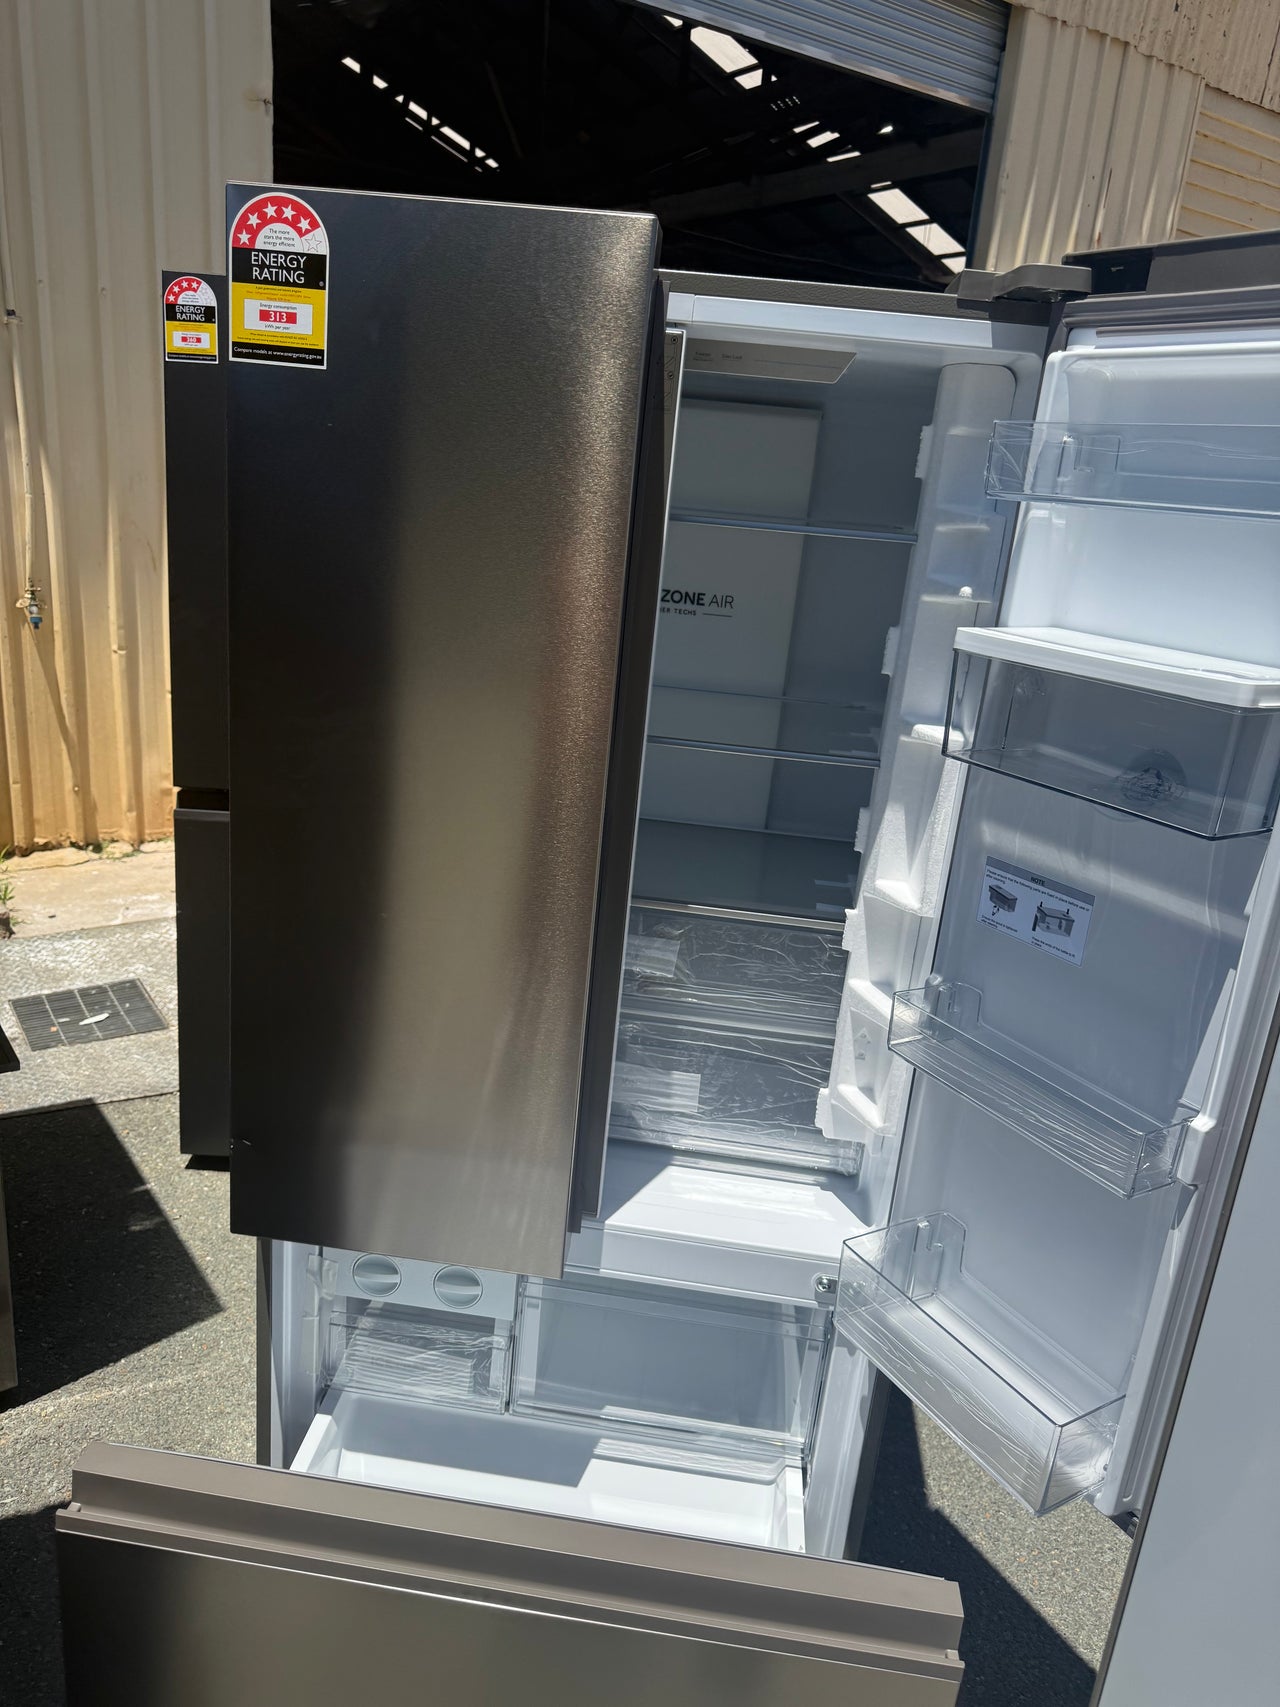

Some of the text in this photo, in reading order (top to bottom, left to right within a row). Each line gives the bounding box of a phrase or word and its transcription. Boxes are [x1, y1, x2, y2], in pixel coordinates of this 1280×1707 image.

[251, 252, 306, 268] ENERGY
[252, 267, 304, 284] RATING
[176, 305, 205, 314] ENERGY
[269, 311, 287, 322] 313
[661, 589, 734, 609] ZONE AIR
[1031, 876, 1046, 886] NOTE
